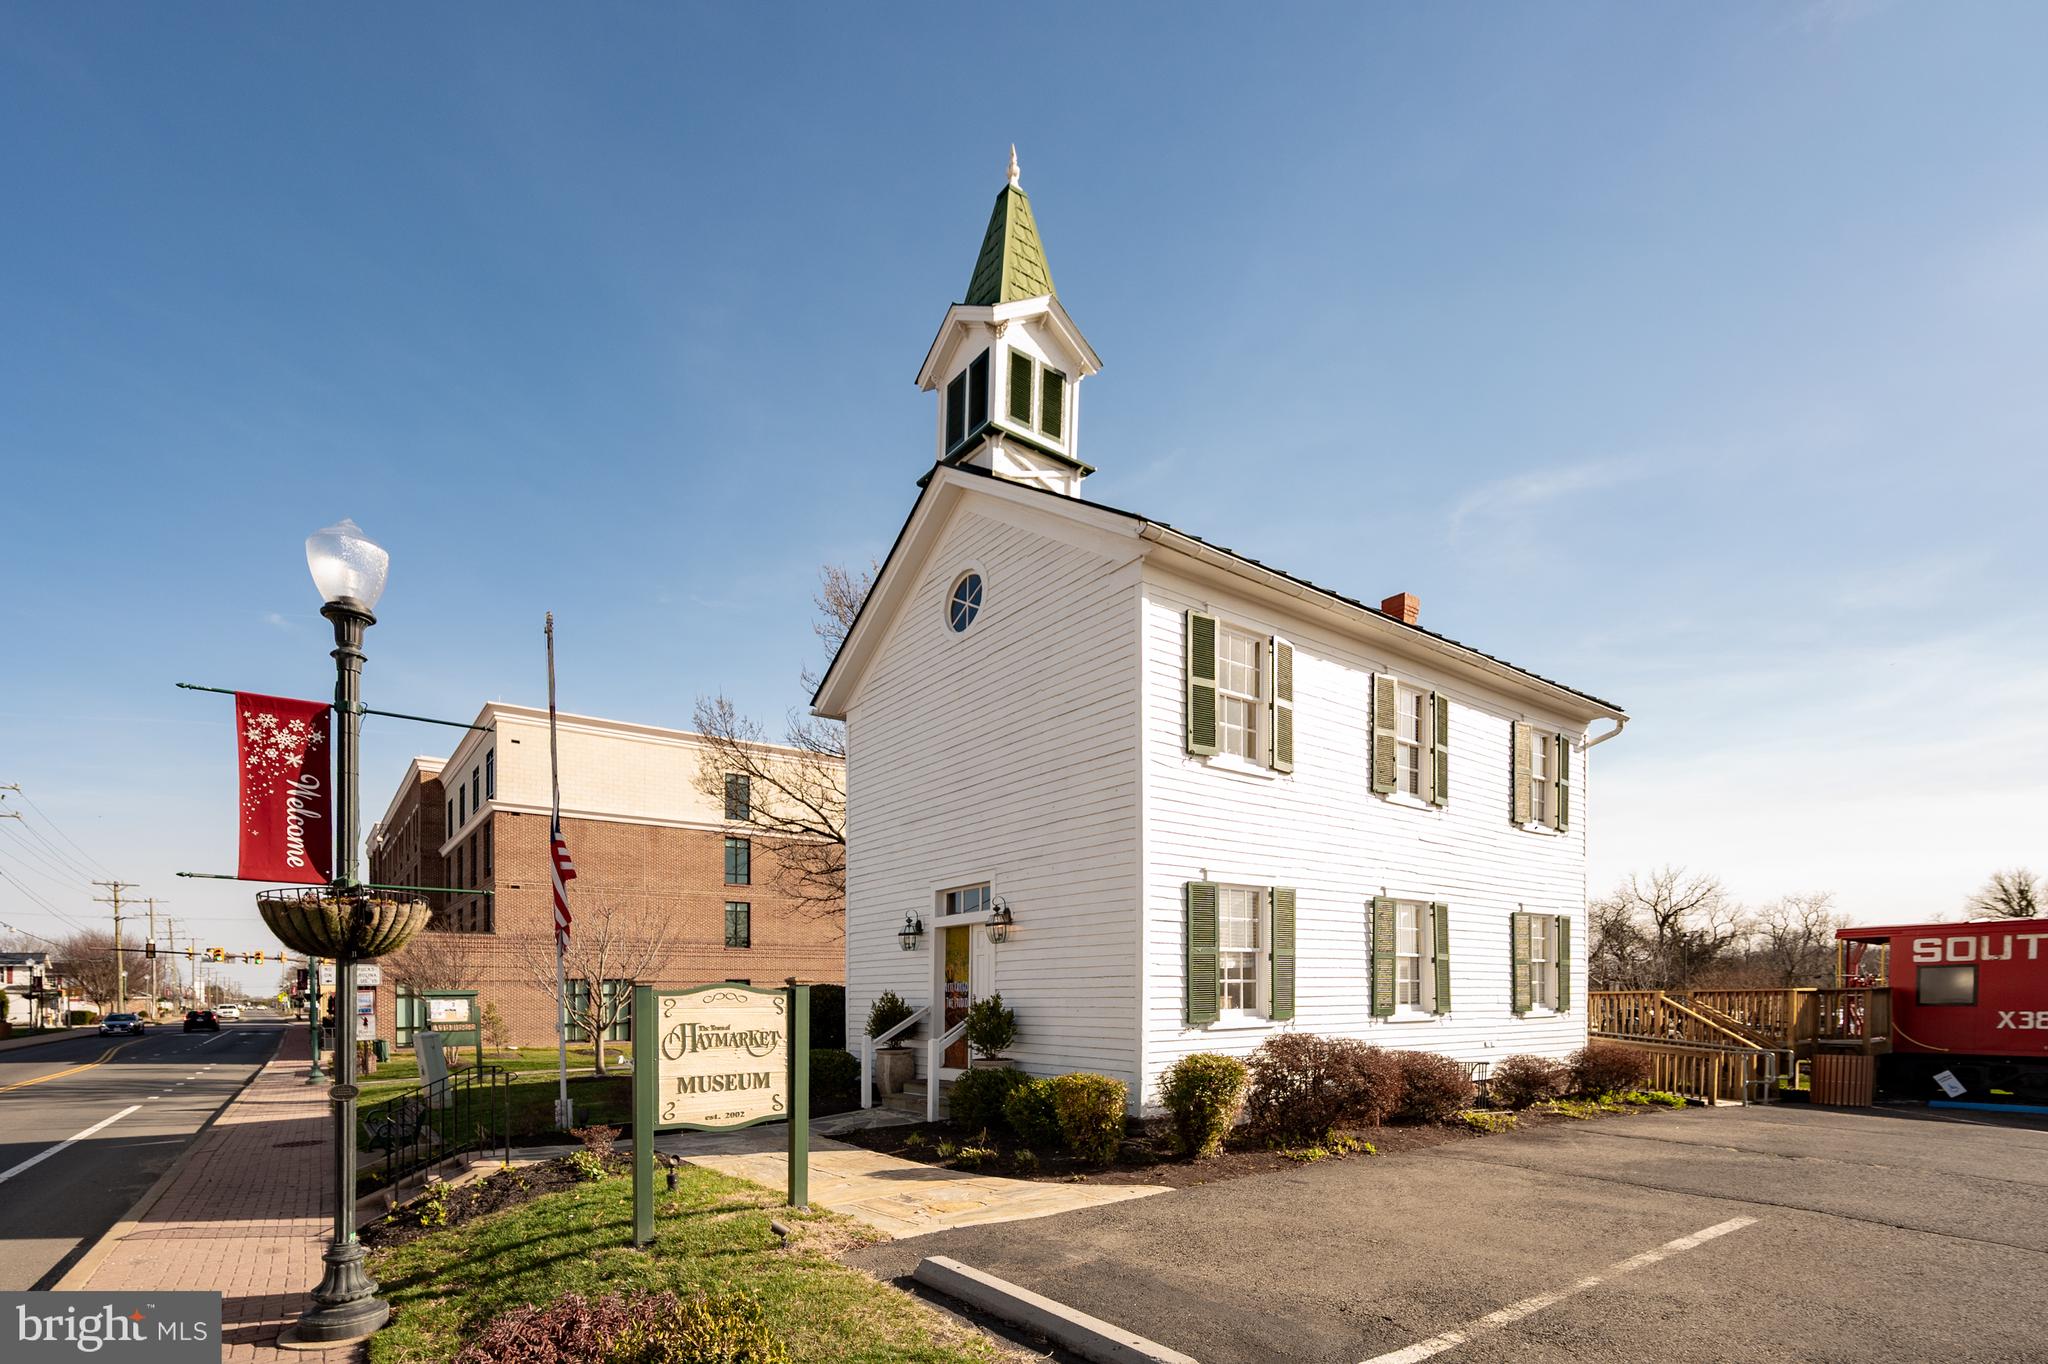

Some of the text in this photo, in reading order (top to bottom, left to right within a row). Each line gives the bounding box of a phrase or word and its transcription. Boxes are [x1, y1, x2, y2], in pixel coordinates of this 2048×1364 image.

[286, 774, 322, 868] Welcome
[1913, 934, 2048, 962] SOUT
[662, 1022, 783, 1060] HAYMARKET
[676, 1072, 771, 1094] MUSEUM
[704, 1111, 745, 1121] est. 2002
